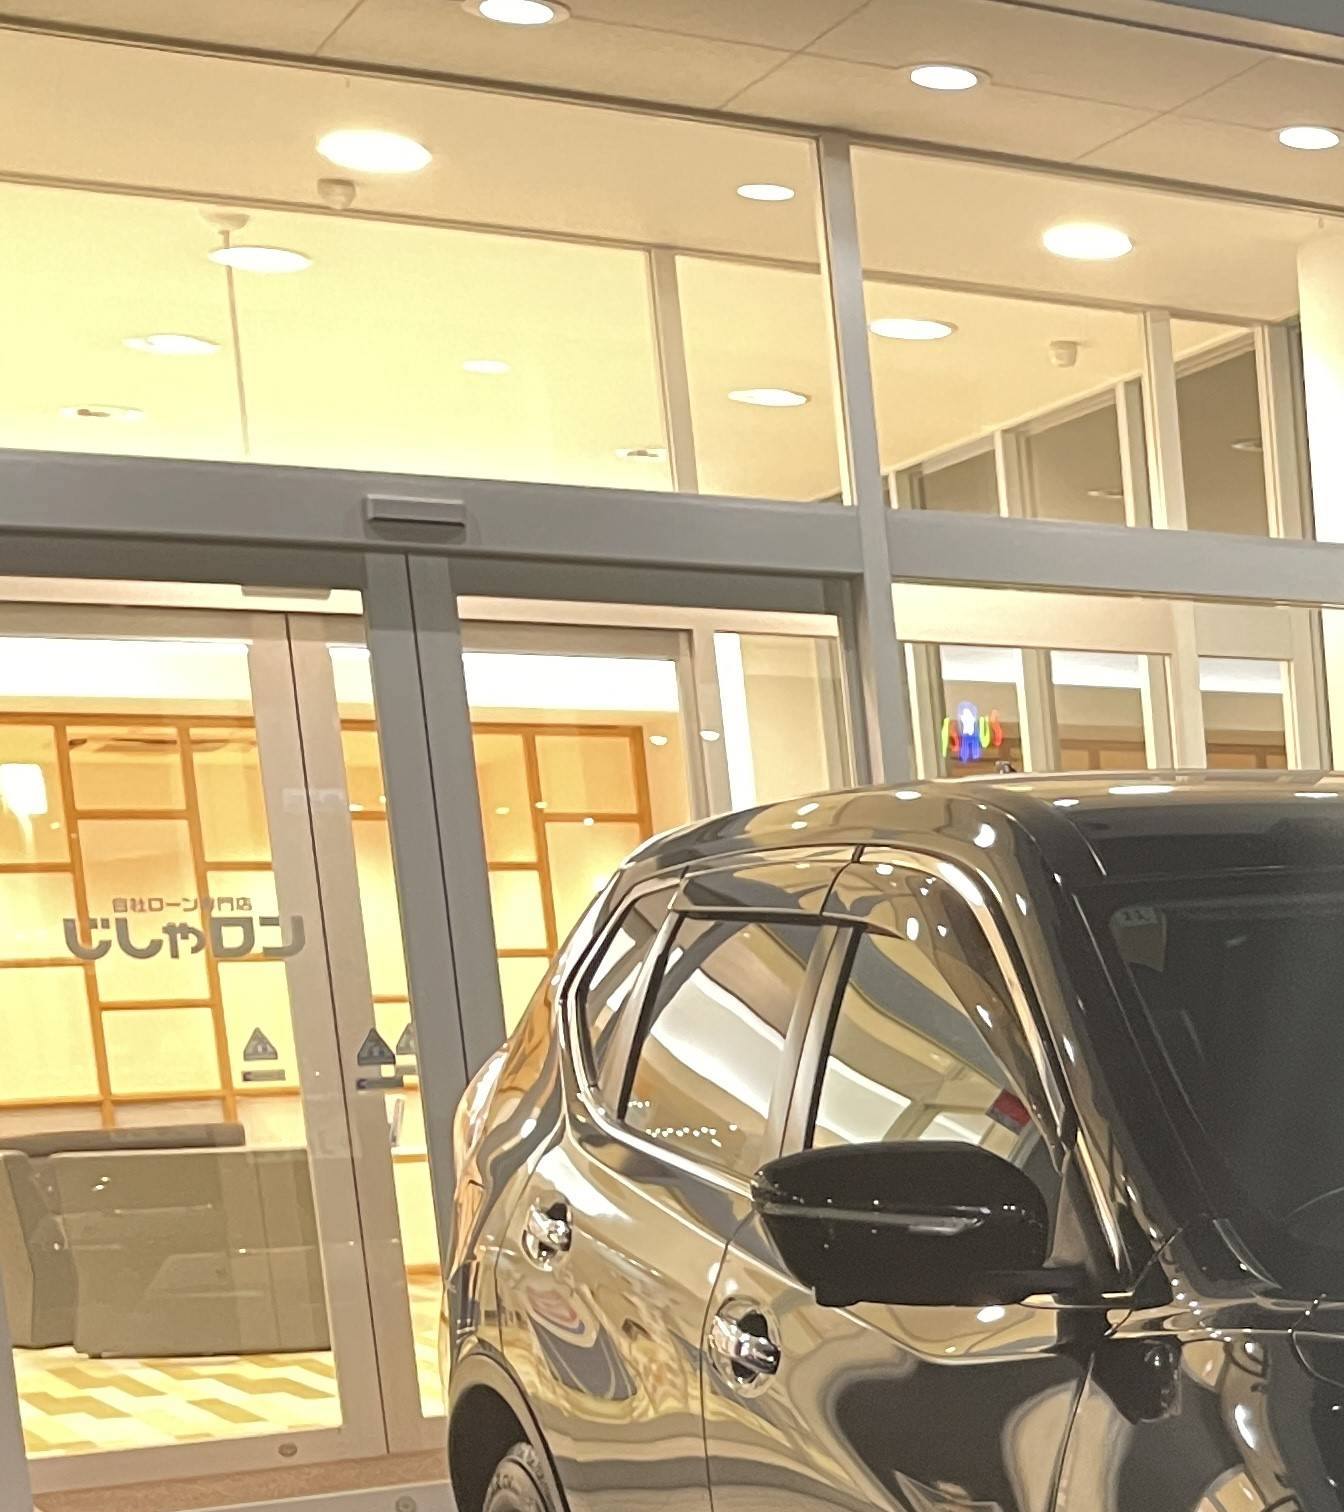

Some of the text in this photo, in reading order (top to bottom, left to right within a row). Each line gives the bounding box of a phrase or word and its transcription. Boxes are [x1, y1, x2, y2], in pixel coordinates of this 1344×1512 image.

[63, 915, 306, 960] じしゃロン
